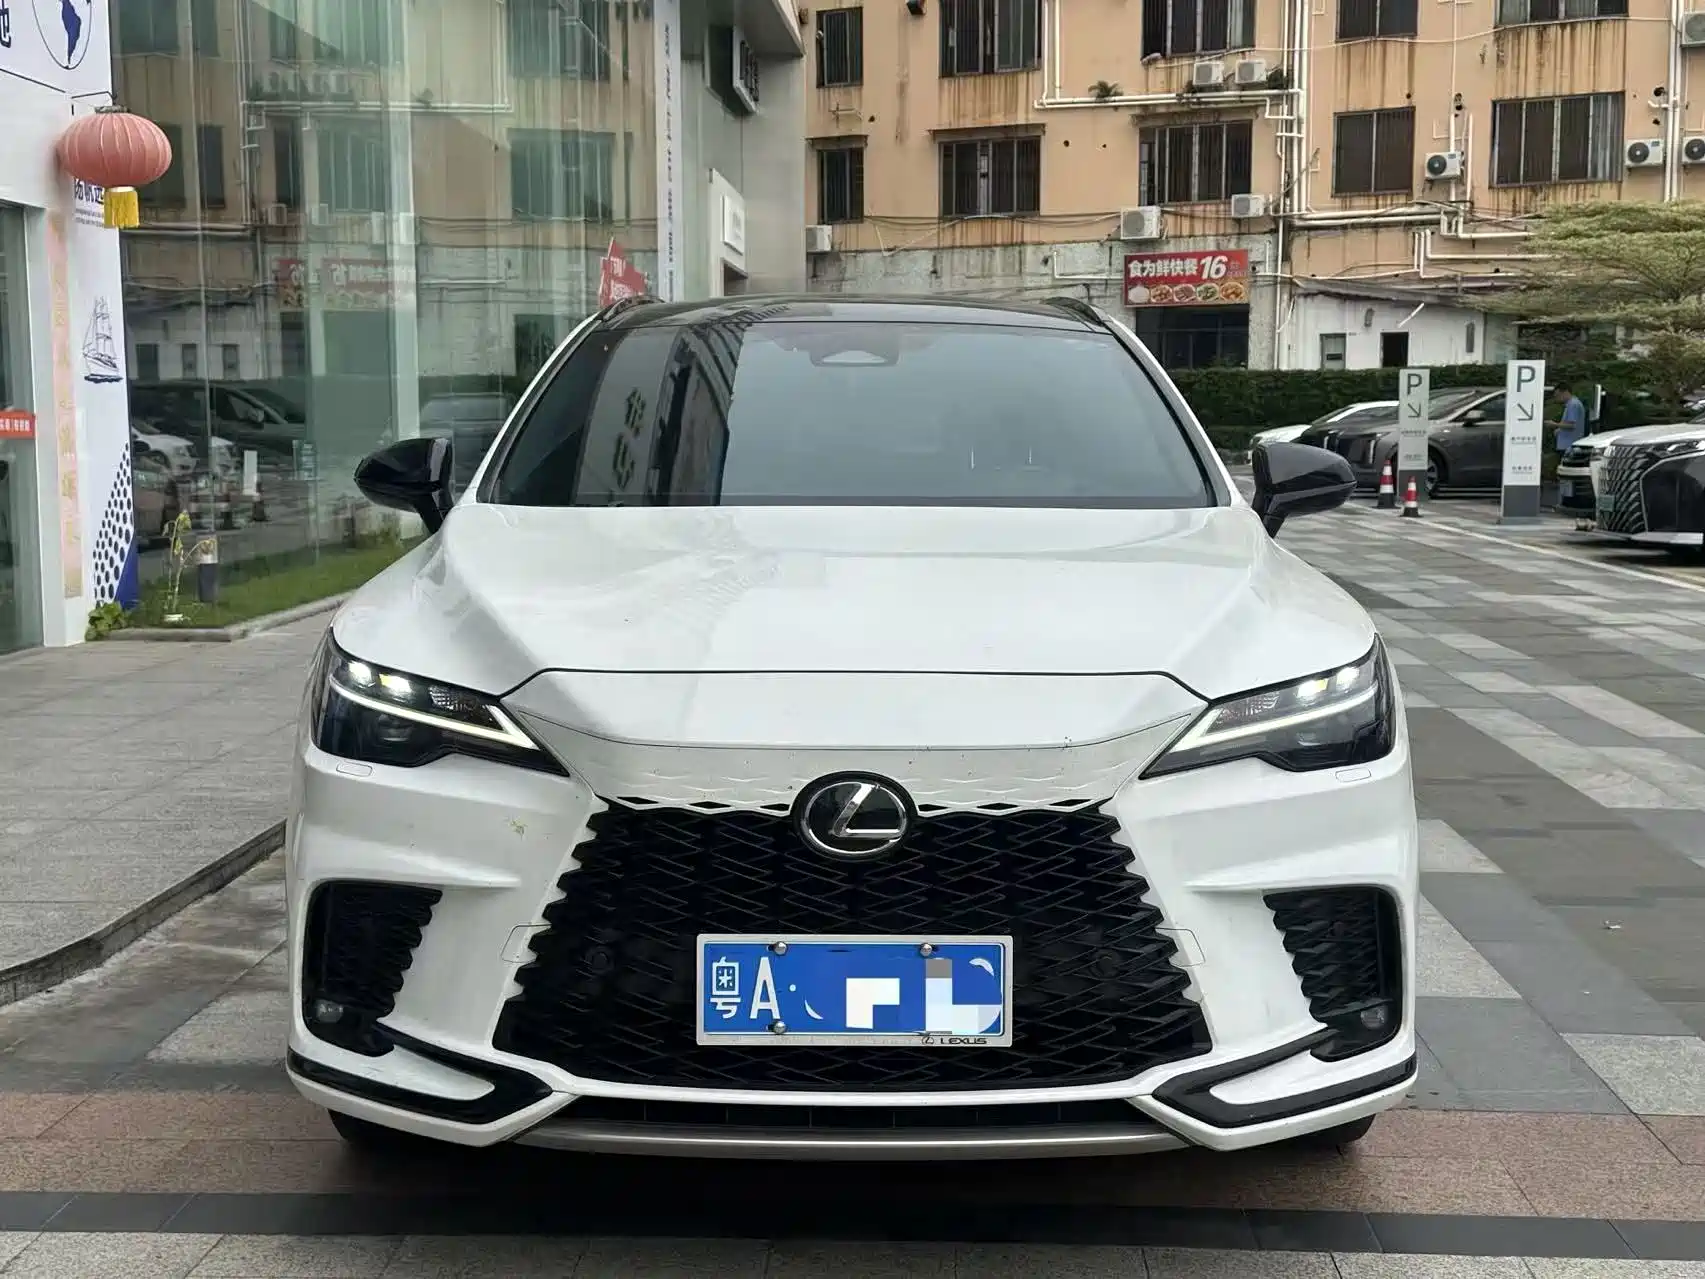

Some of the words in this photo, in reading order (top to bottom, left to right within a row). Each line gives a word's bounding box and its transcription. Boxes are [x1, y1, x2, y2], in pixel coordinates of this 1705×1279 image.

[1127, 257, 1198, 279] 食为鲜快餐
[1200, 255, 1228, 280] 16
[1407, 373, 1423, 396] P
[1516, 365, 1536, 393] P
[940, 1037, 987, 1045] LEXUS
